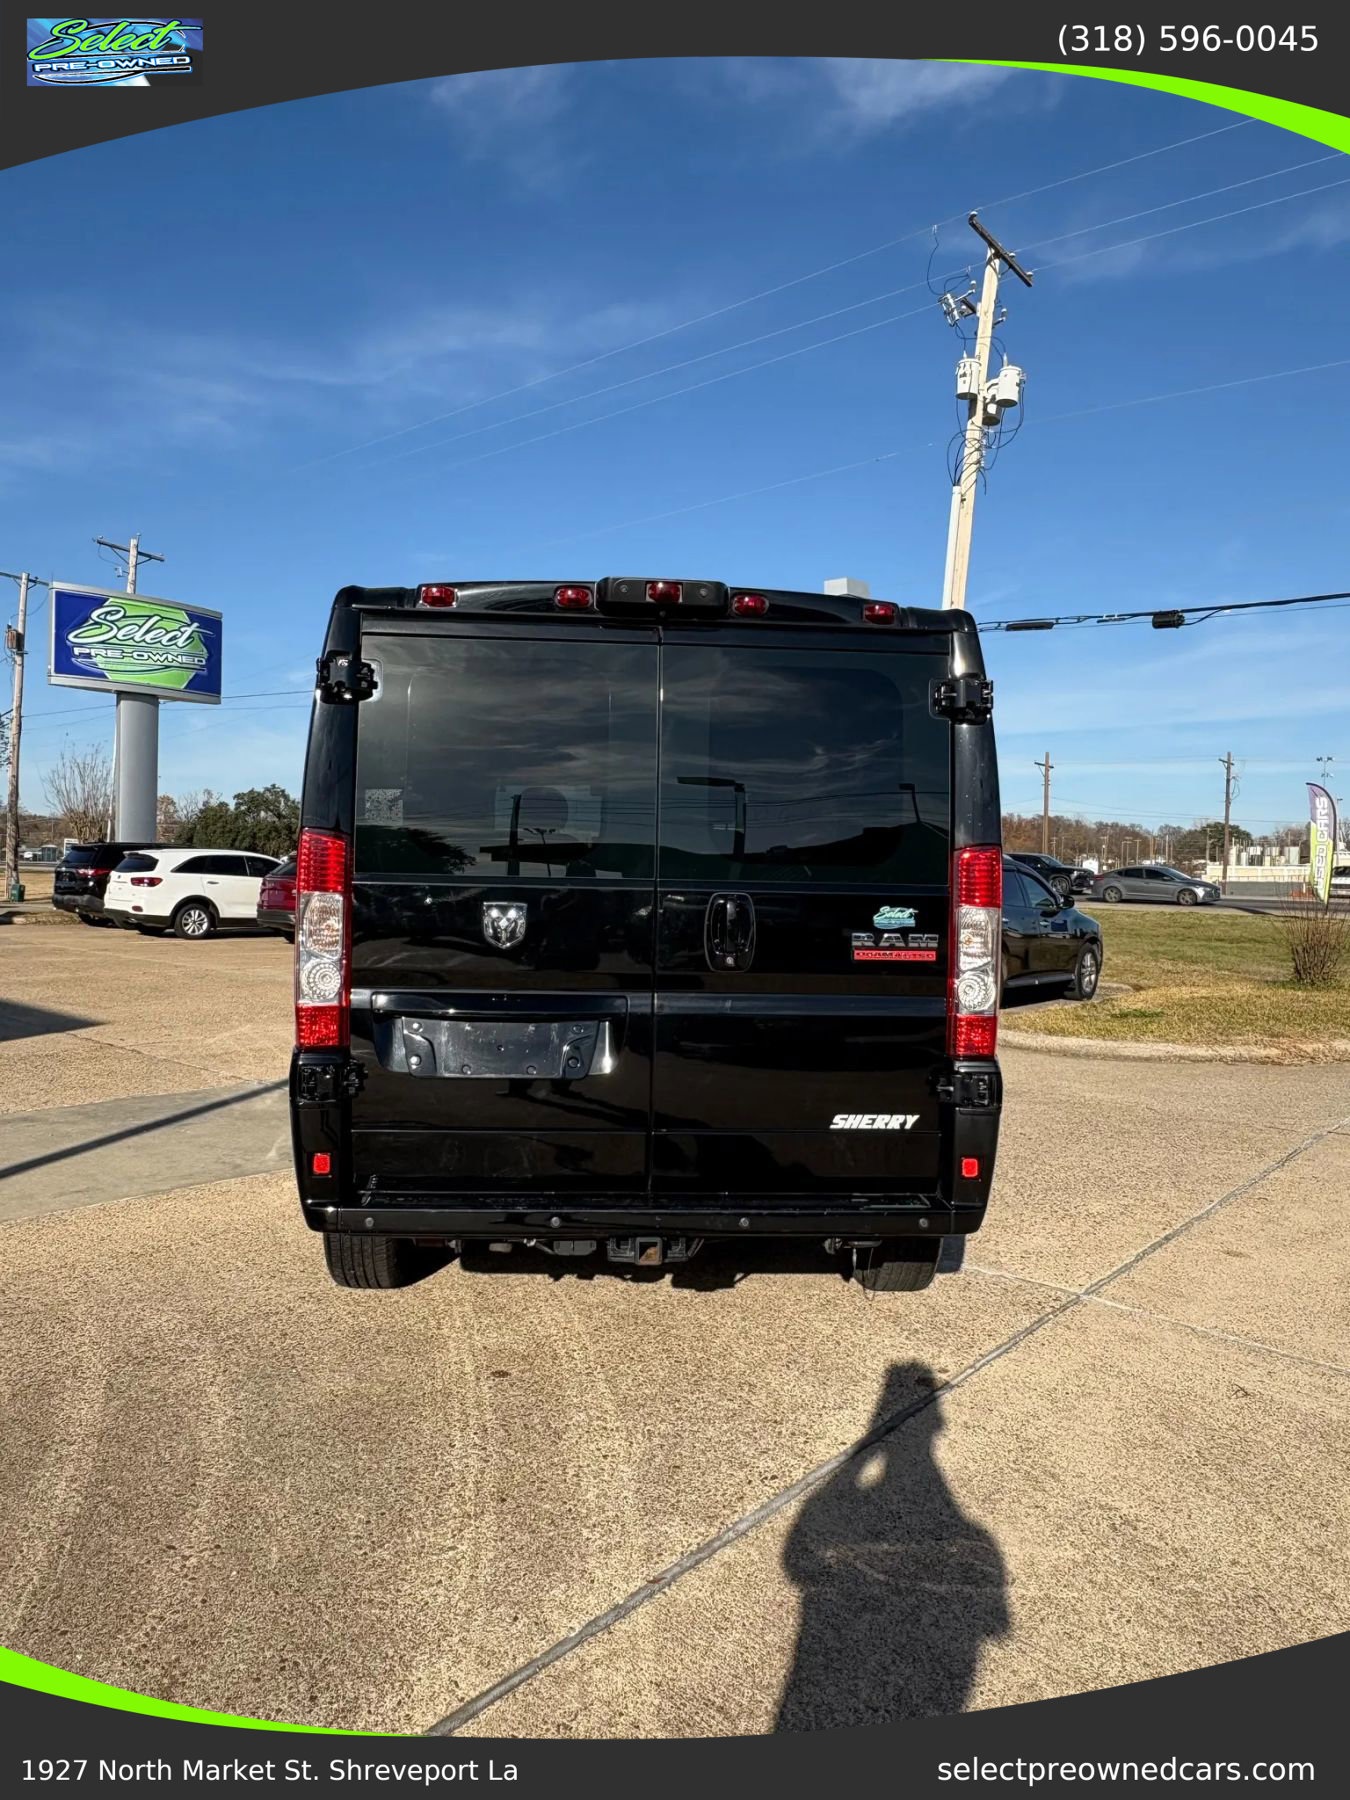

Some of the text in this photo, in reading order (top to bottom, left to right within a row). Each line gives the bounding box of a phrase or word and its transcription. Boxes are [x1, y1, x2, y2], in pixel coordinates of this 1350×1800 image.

[67, 606, 214, 648] Select
[73, 647, 206, 666] PRE-OWNED
[1315, 797, 1329, 842] CARS
[851, 932, 939, 947] RAM
[829, 1114, 920, 1130] SHERRY
